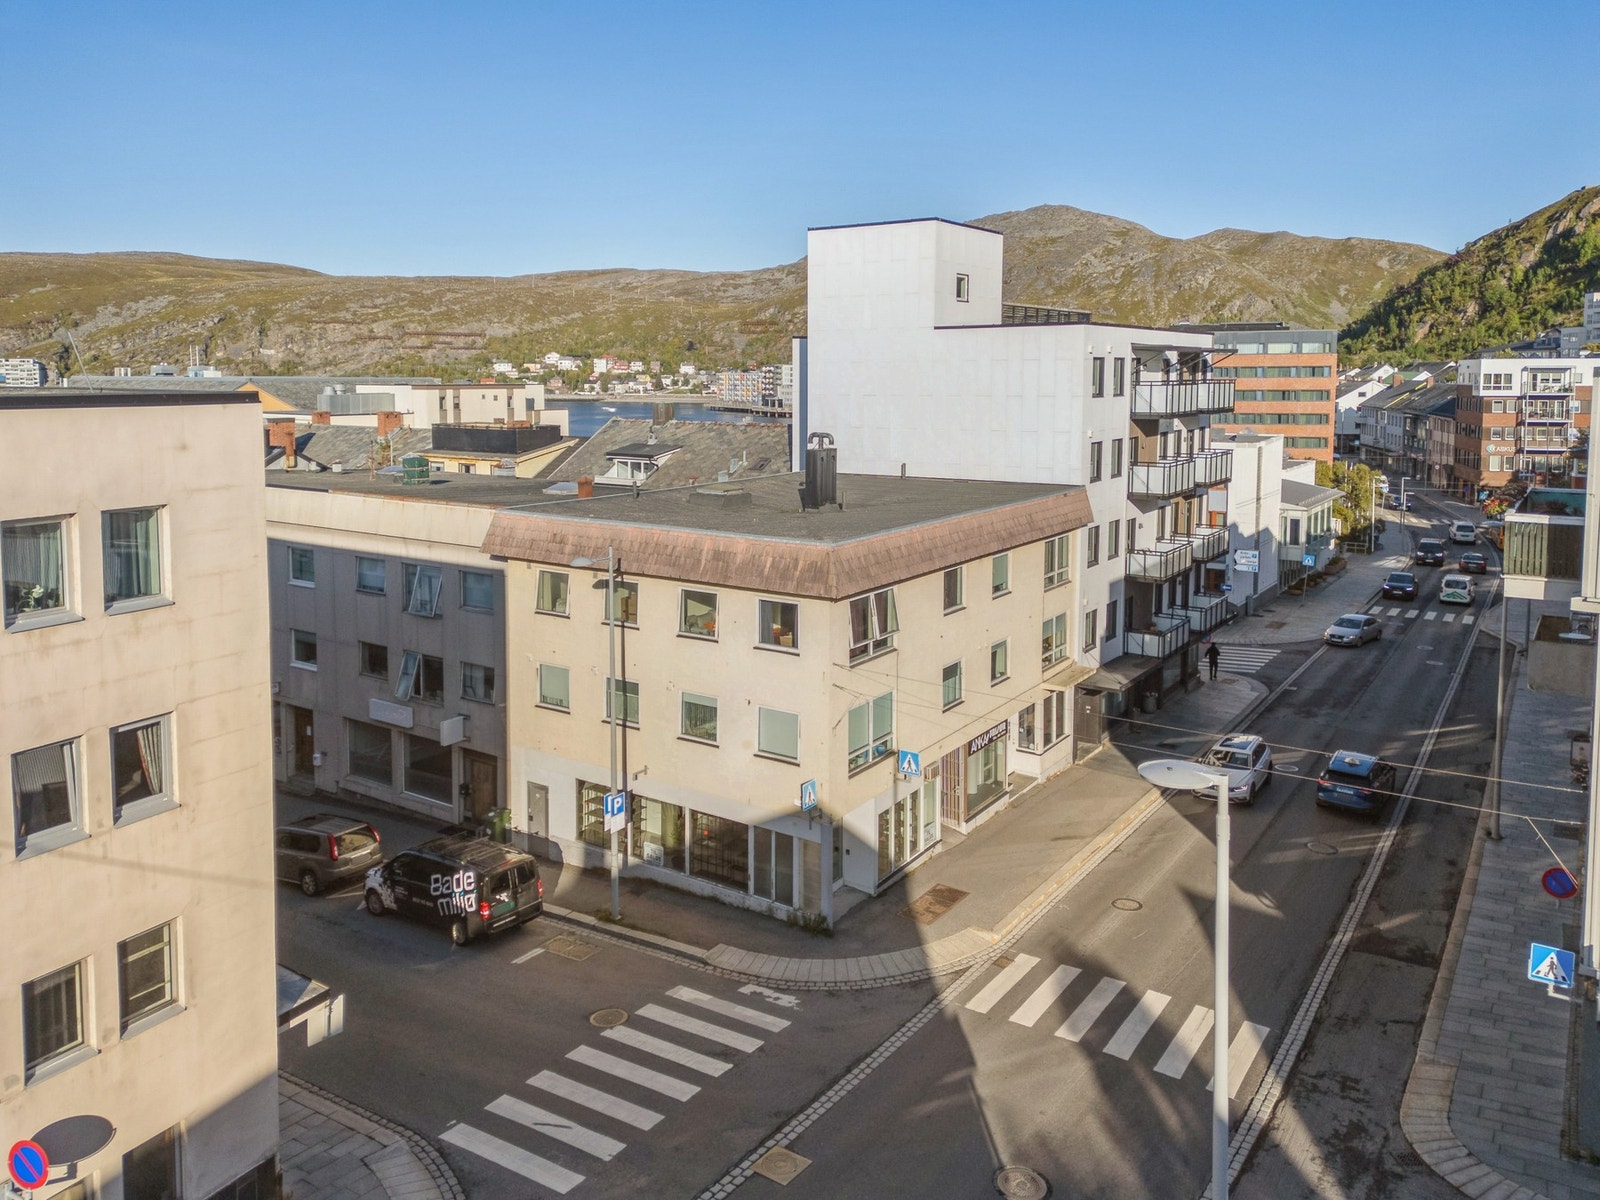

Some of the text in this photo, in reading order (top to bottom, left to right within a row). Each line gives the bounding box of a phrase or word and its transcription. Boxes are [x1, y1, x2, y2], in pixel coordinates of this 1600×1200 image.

[613, 797, 622, 814] P
[430, 870, 475, 896] Bade
[437, 889, 478, 917] miljø
